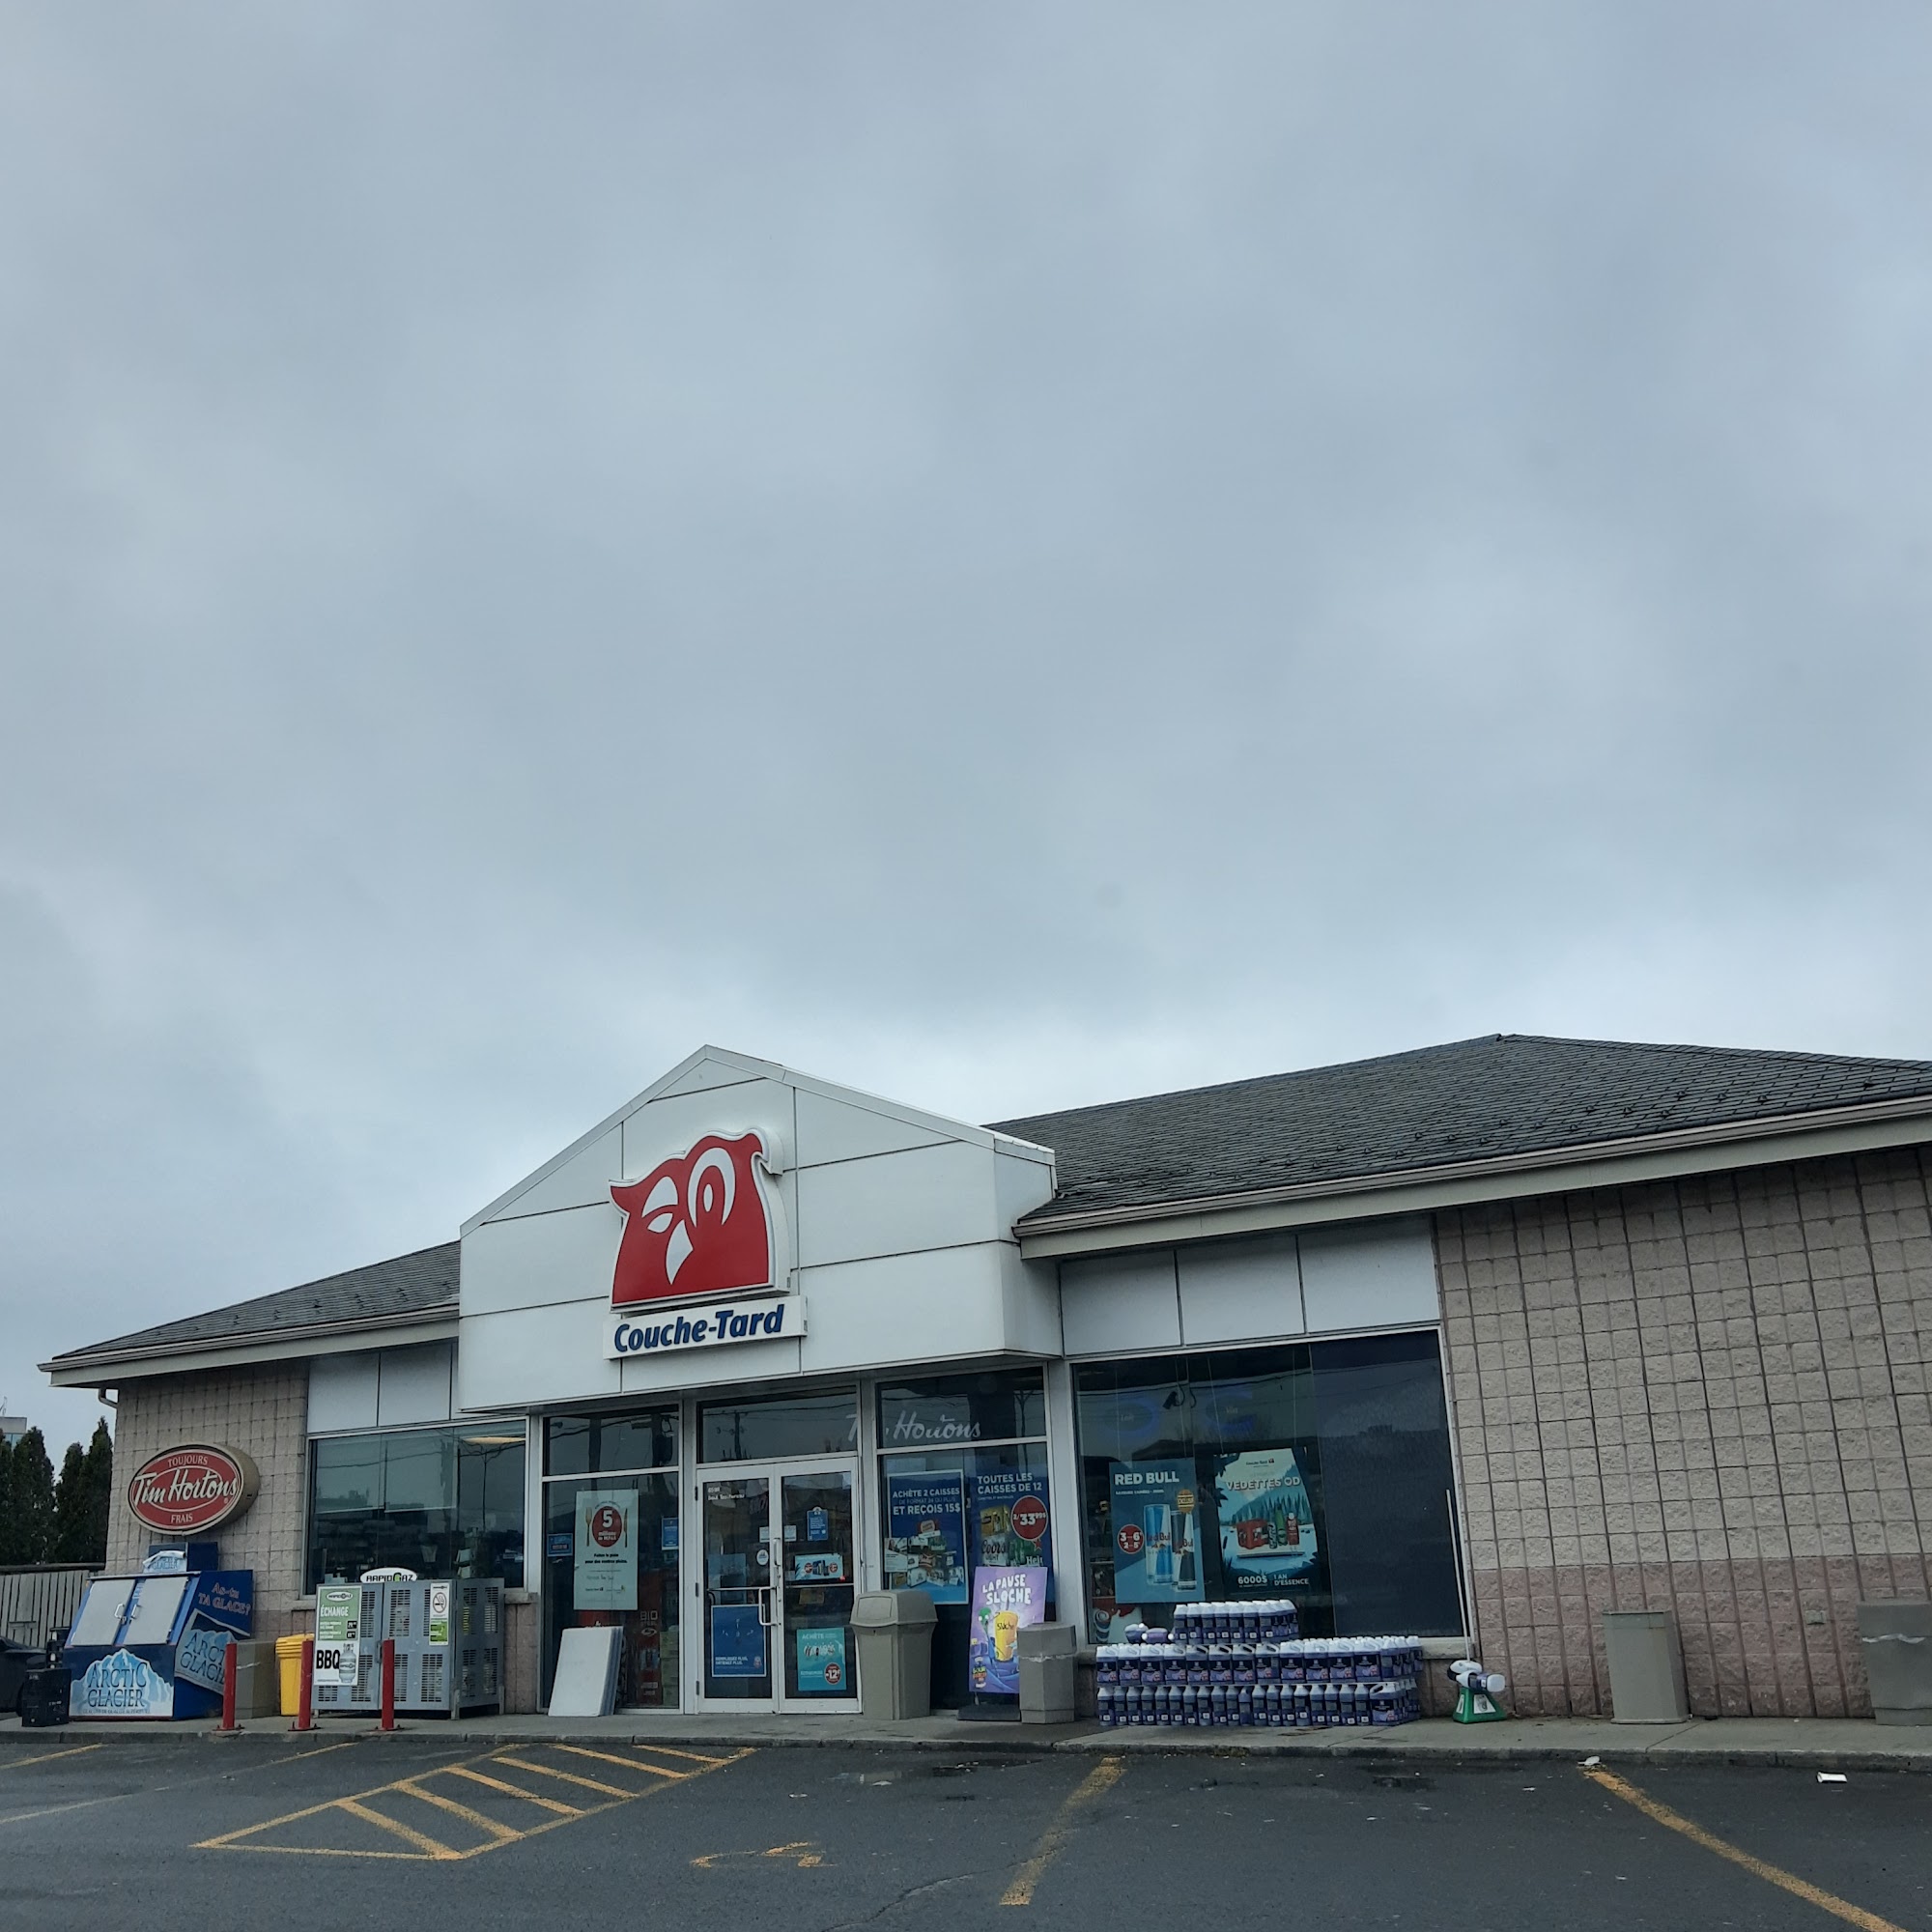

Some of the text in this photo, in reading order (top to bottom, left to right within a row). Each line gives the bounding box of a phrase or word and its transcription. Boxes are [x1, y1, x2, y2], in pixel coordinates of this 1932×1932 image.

[614, 1304, 784, 1352] Couche-Tard
[168, 1455, 209, 1467] TOUJOURS
[978, 1472, 1033, 1485] TOUTES LES
[1114, 1471, 1179, 1486] RED BULL
[1226, 1478, 1282, 1491] VEDETTES
[134, 1469, 237, 1507] Tim Hortons
[893, 1489, 922, 1498] ACHÈTE
[929, 1488, 960, 1496] CAISSES
[978, 1482, 1042, 1494] CAISSES DE 12
[893, 1502, 960, 1516] ET REÇOIS 15$
[170, 1513, 193, 1523] FRAIS
[602, 1510, 613, 1528] 5
[982, 1574, 1026, 1593] LA PAUSE
[1237, 1575, 1268, 1585] 6000$
[1273, 1577, 1310, 1586] D'ESSENCE
[198, 1592, 251, 1616] TA GLACE?
[985, 1587, 1032, 1605] SLOCHE
[320, 1605, 349, 1617] ÉCHANGE
[185, 1633, 225, 1666] ARCT
[316, 1649, 340, 1669] BBQ
[88, 1662, 148, 1689] ARCTIC
[181, 1651, 225, 1684] GLACI
[87, 1689, 146, 1708] GLACIER
